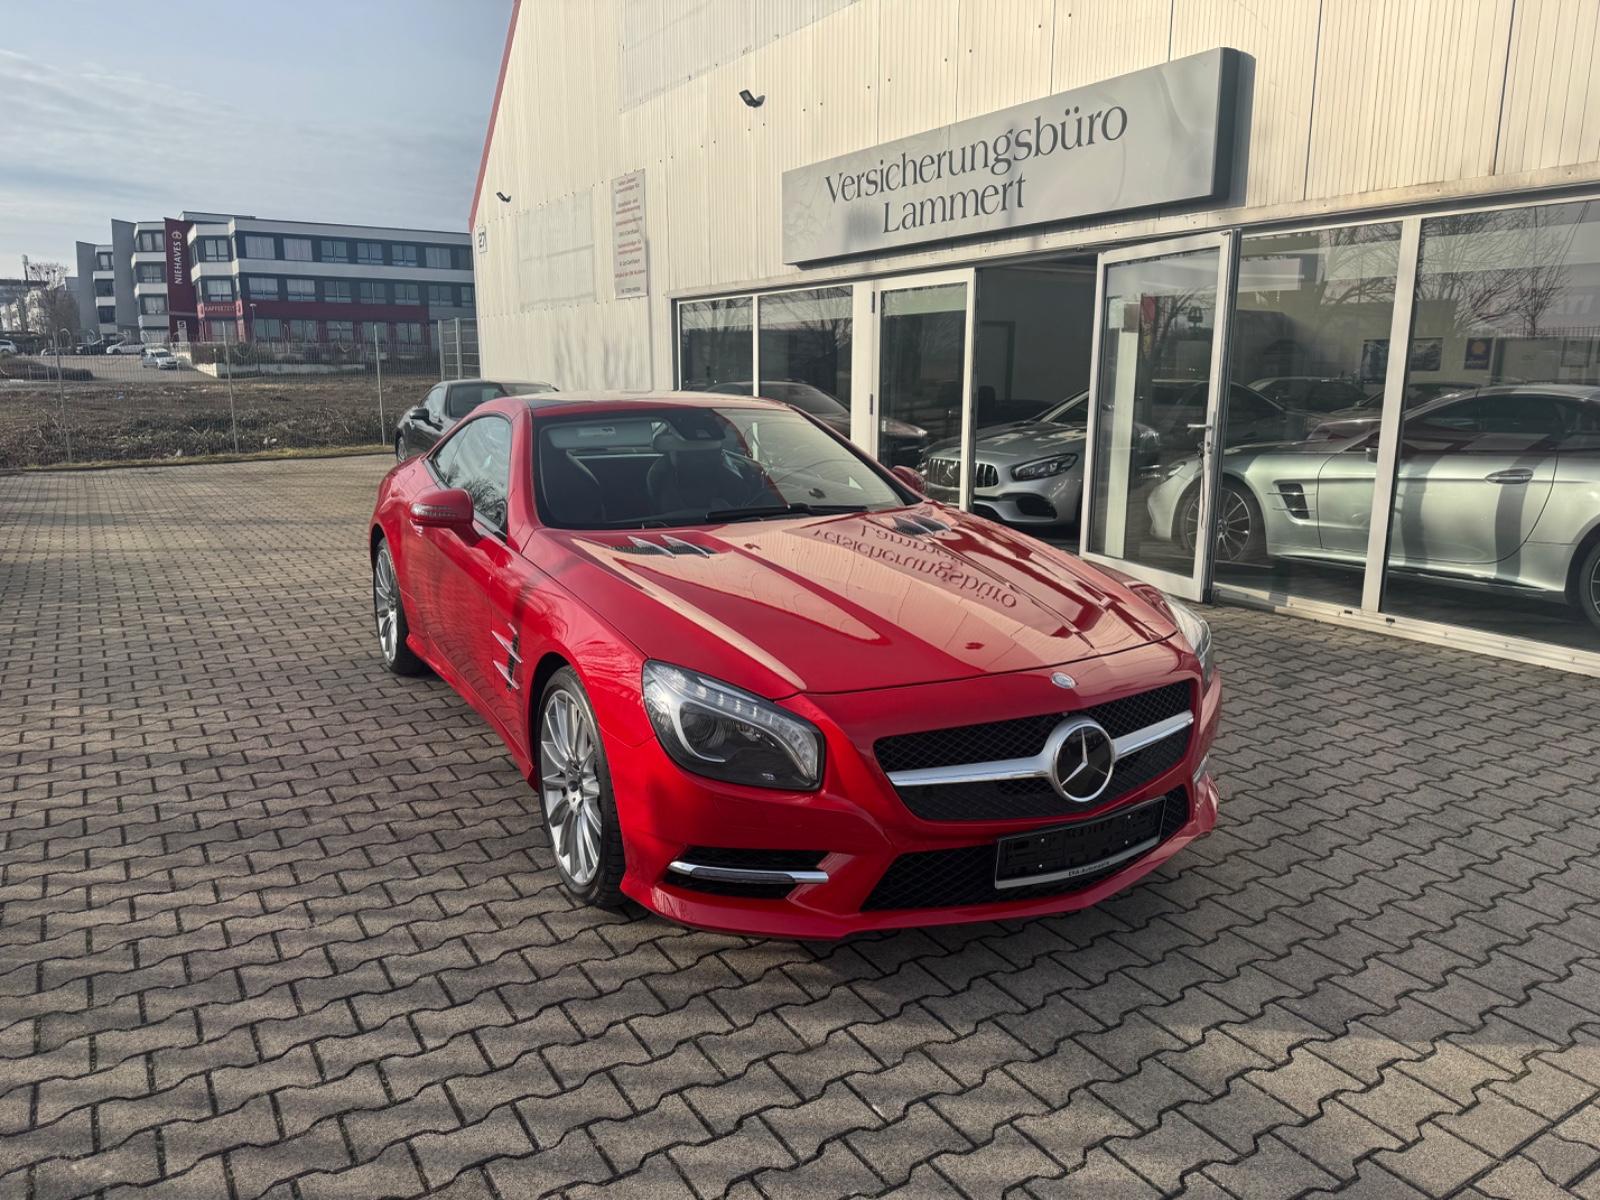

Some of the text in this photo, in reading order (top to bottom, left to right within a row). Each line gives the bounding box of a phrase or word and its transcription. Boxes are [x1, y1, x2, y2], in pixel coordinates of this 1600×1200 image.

[825, 105, 1128, 204] Versicherungsbüro
[882, 173, 1026, 234] Lammert
[173, 241, 182, 285] NIEHAVES
